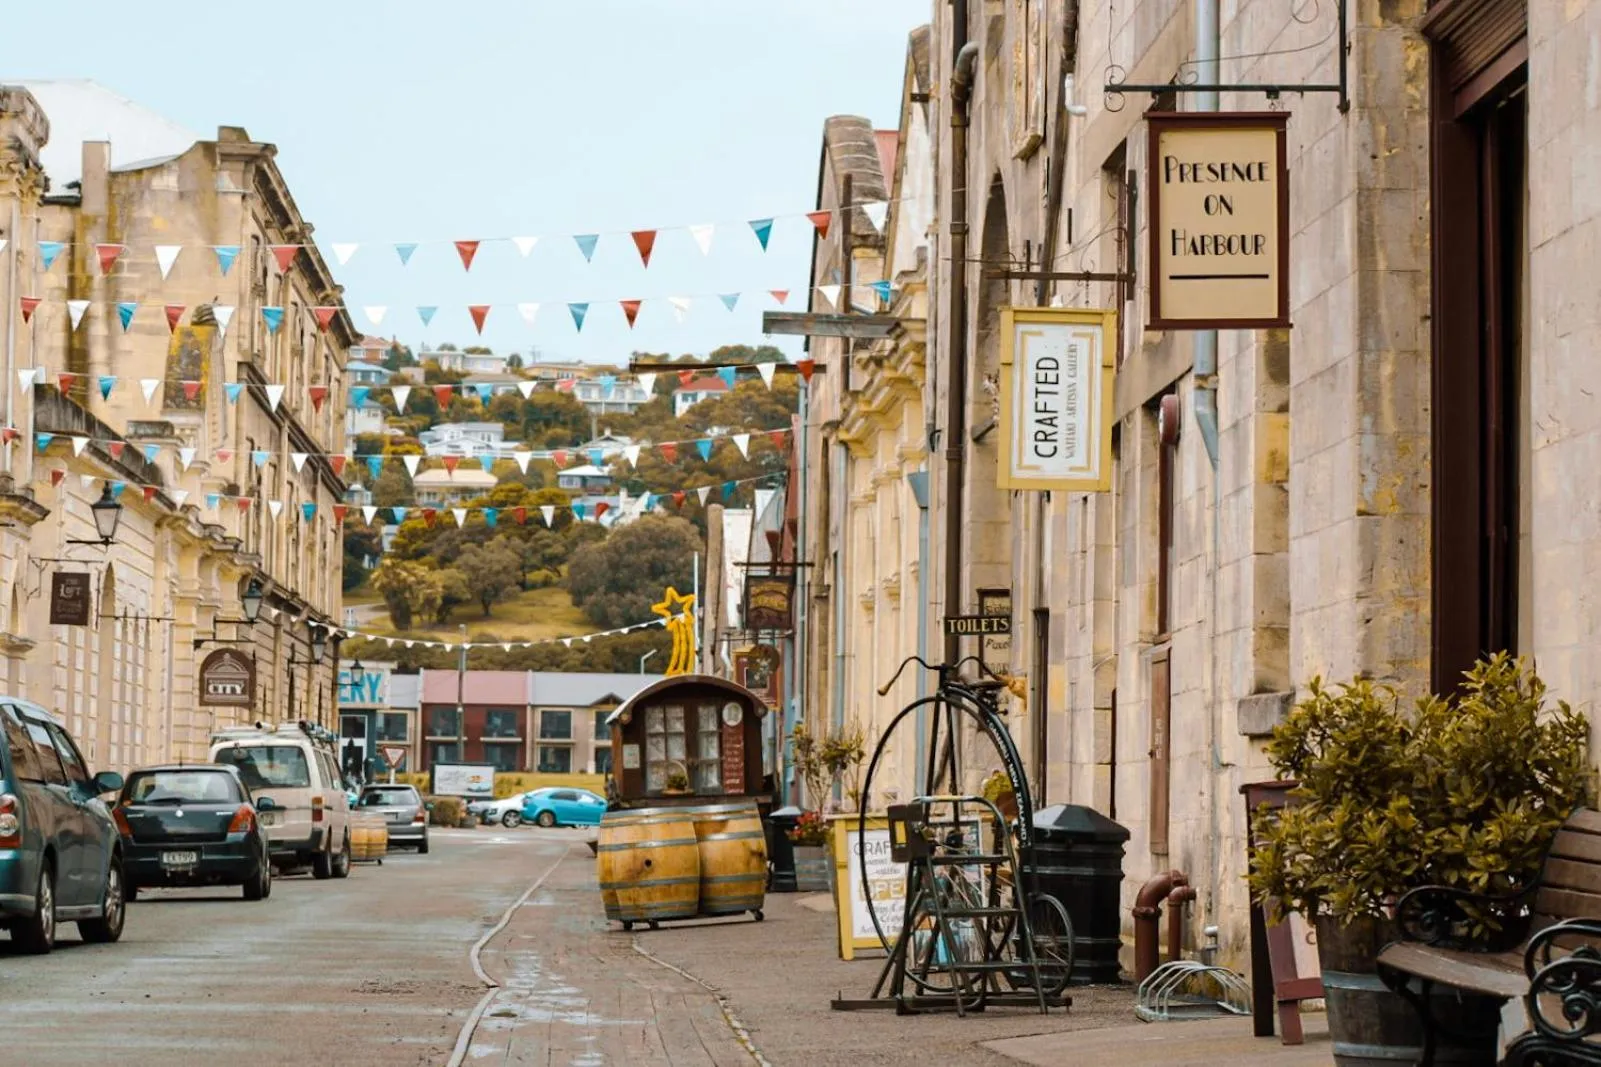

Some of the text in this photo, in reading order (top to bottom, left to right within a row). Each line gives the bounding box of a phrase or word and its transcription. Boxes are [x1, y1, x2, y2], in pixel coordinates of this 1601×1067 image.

[1034, 356, 1059, 459] CRAFTED
[947, 618, 1009, 633] TOILETS
[208, 683, 245, 694] CITY
[1008, 763, 1019, 788] NEW
[1016, 791, 1028, 841] ZEALAND
[853, 841, 892, 856] CRAF
